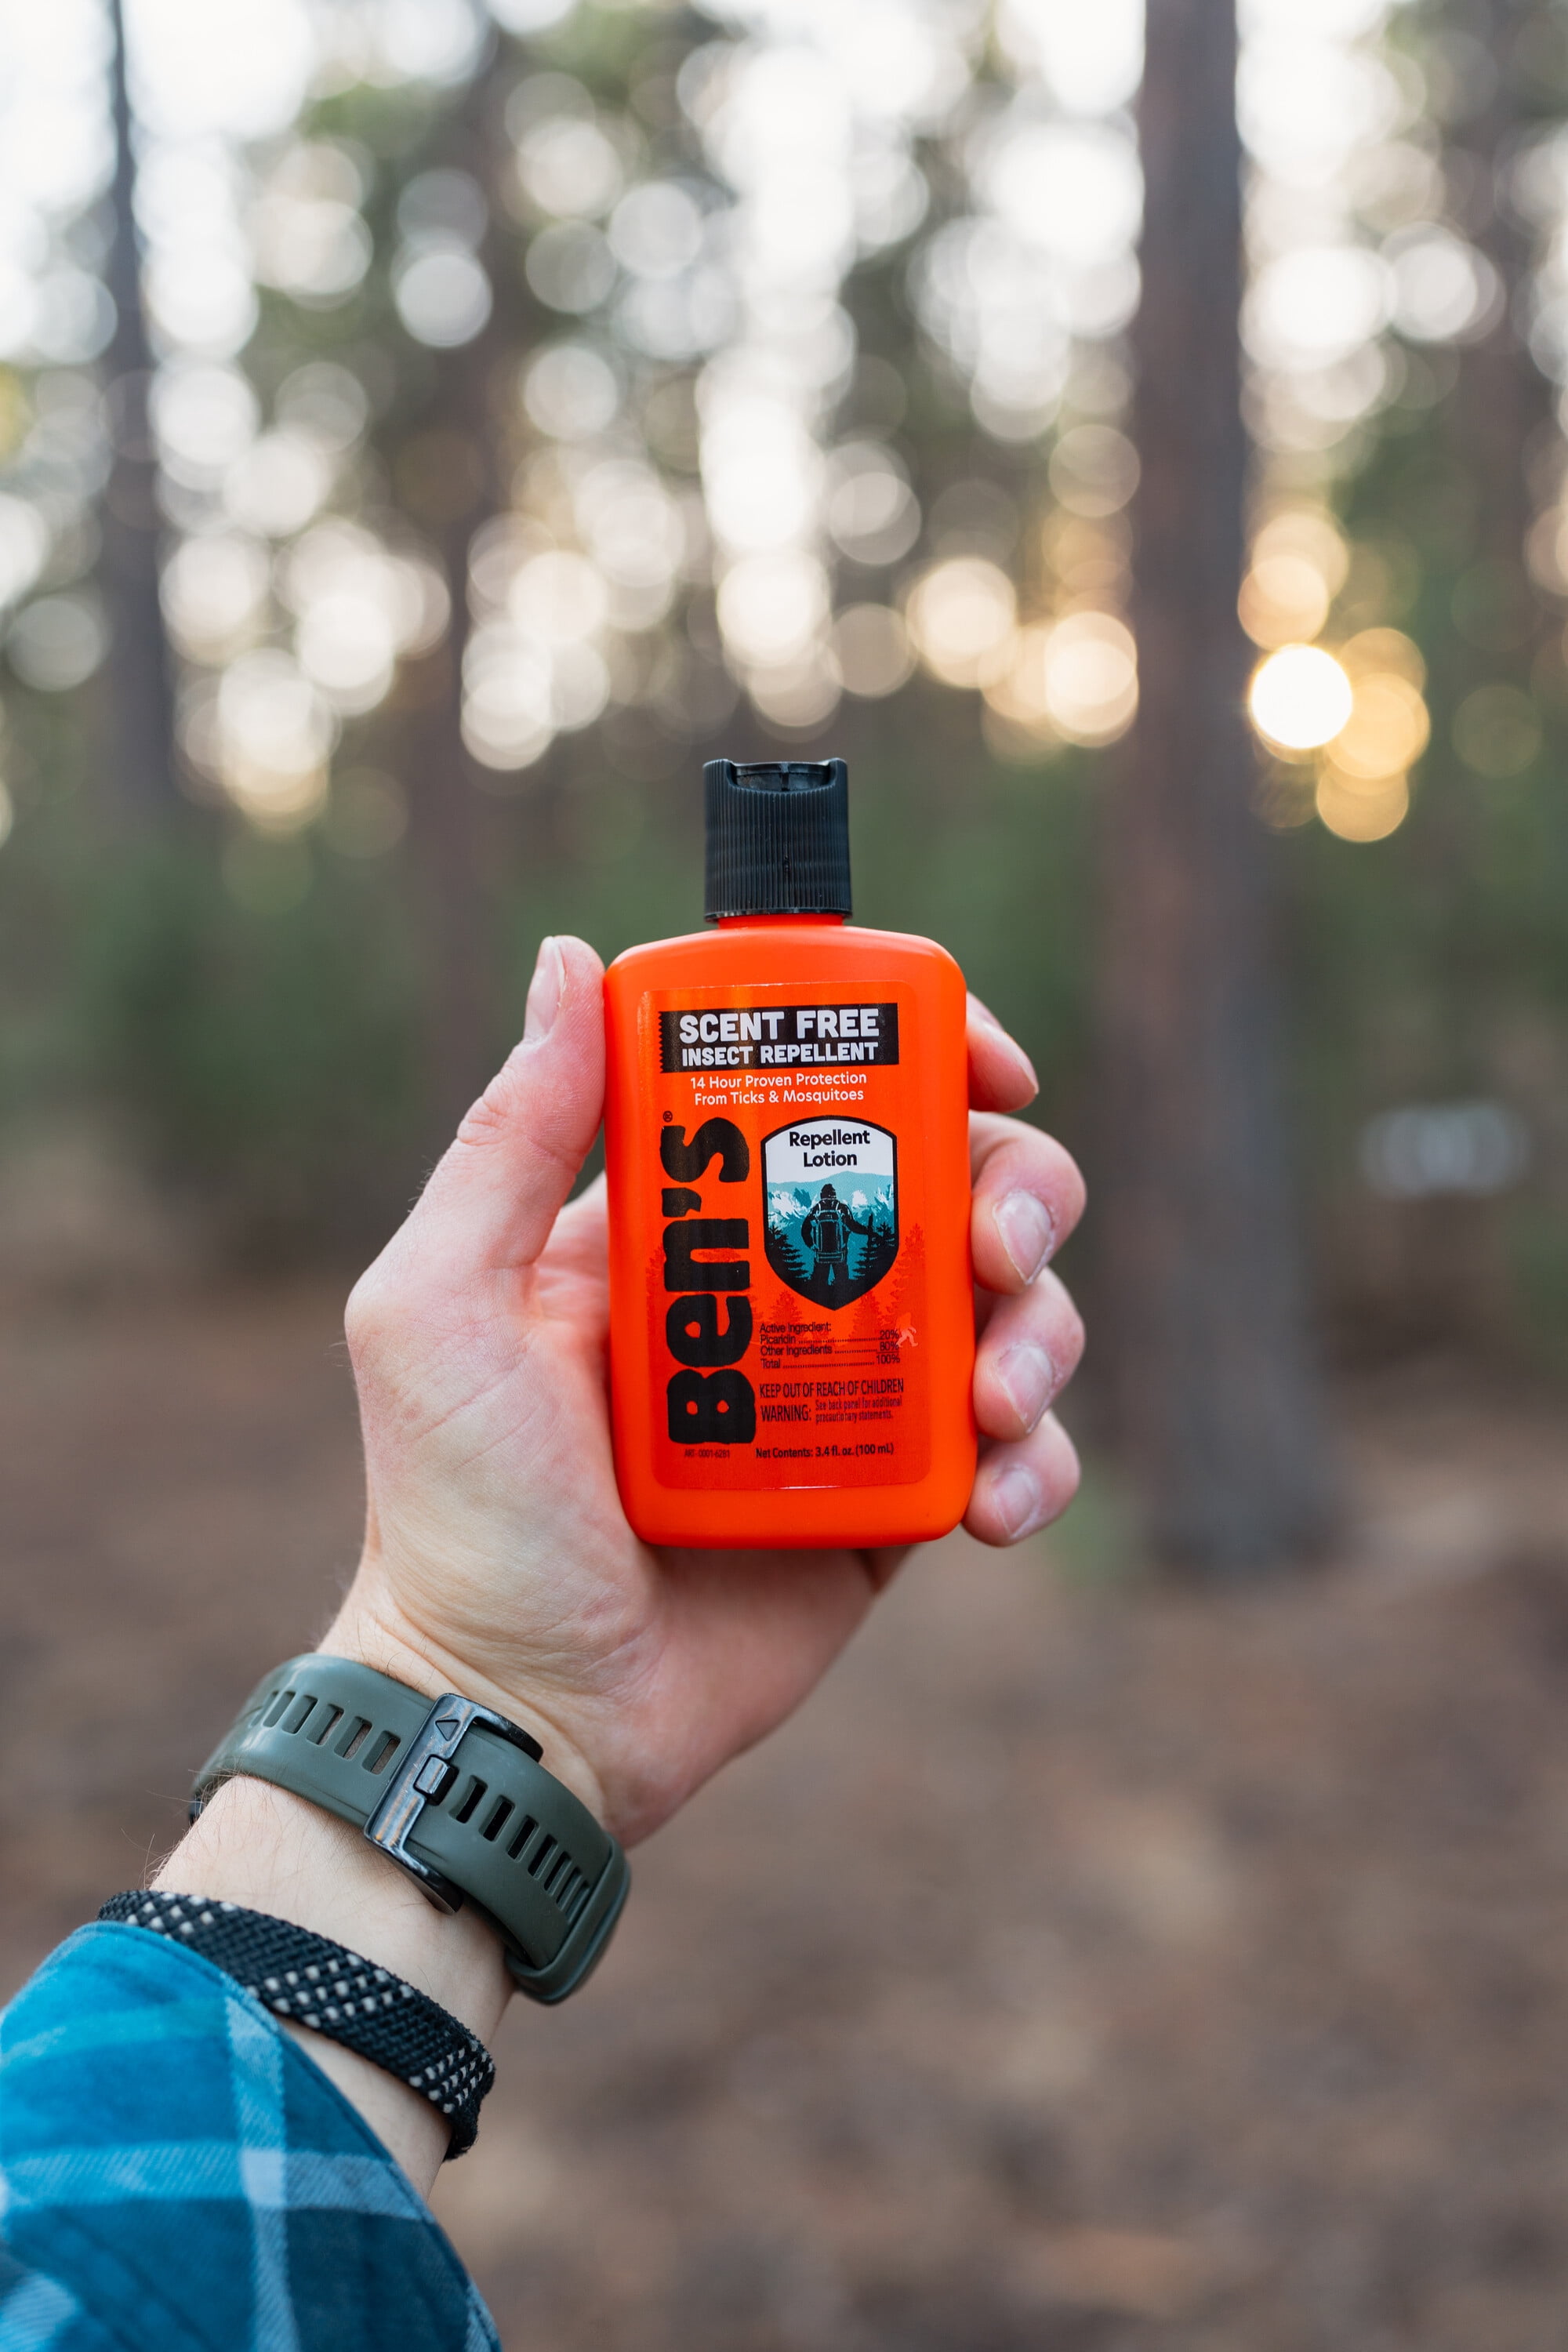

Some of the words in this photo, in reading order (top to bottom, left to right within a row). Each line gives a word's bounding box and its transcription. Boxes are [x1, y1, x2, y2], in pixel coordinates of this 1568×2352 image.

[679, 1011, 784, 1044] SCENT
[796, 1008, 880, 1039] FREE
[681, 1046, 753, 1067] INSECT
[760, 1042, 879, 1064] REPELLENT
[690, 1076, 706, 1089] 14
[709, 1076, 742, 1089] Hour
[745, 1074, 792, 1088] Proven
[796, 1071, 867, 1086] Protection
[695, 1093, 728, 1105] From
[730, 1090, 765, 1105] Ticks
[768, 1090, 779, 1103] &
[782, 1087, 864, 1105] Mosquitoes
[789, 1129, 870, 1150] Repellent
[803, 1150, 858, 1167] Lotion
[760, 1323, 786, 1334] Active
[787, 1322, 832, 1335] Ingredient:
[880, 1330, 899, 1340] 20%
[760, 1345, 783, 1356] Other
[786, 1345, 833, 1358] Ingredients
[760, 1358, 781, 1369] Total
[876, 1354, 900, 1365] 100%
[759, 1383, 782, 1399] KEEP
[782, 1382, 800, 1398] OUT
[802, 1382, 814, 1397] OF
[816, 1381, 845, 1397] REACH
[848, 1380, 859, 1396] OF
[861, 1377, 904, 1396] CHILDREN
[760, 1404, 812, 1422] WARNING:
[755, 1447, 771, 1459] Net
[772, 1446, 814, 1459] Contents:
[815, 1446, 829, 1457] 3.4
